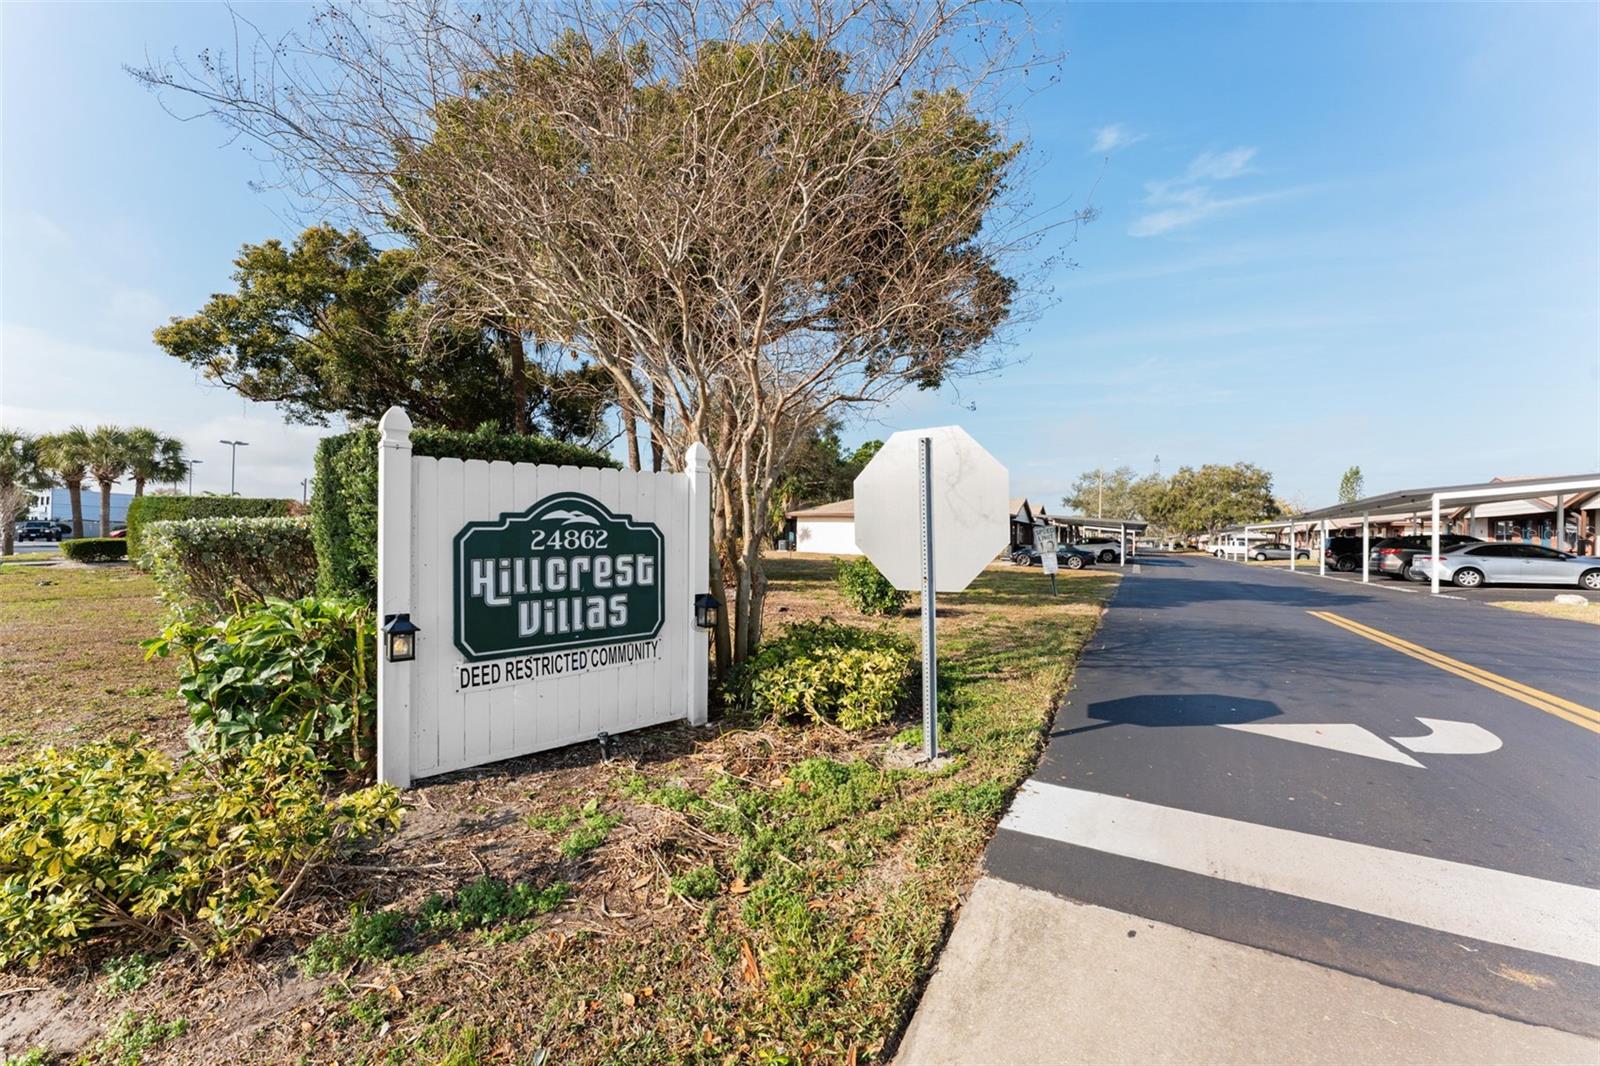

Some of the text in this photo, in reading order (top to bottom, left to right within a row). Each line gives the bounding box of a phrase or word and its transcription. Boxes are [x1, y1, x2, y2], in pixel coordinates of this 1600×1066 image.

[531, 529, 608, 550] 24862
[470, 553, 654, 607] Hillcrest
[518, 593, 628, 638] Villas
[460, 640, 659, 688] DEED RESTRICTED COMMUNITY
